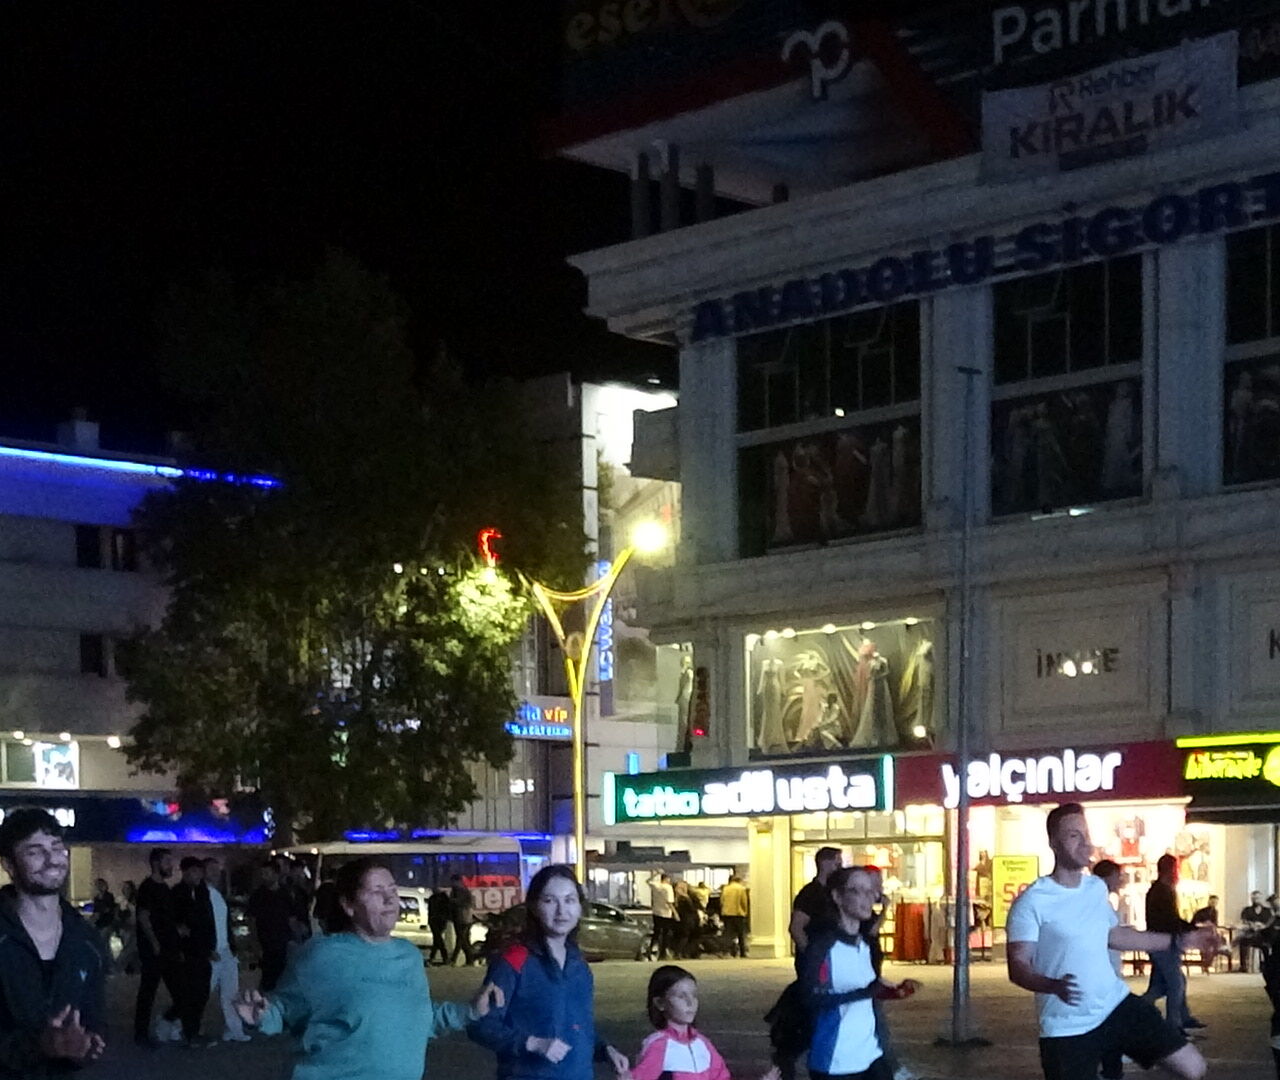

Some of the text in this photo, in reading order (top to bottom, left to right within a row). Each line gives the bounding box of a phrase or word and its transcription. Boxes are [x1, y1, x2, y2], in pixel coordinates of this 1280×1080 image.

[692, 235, 996, 342] ANADOLU
[776, 765, 876, 811] usta
[941, 748, 1122, 809] yalçınlar
